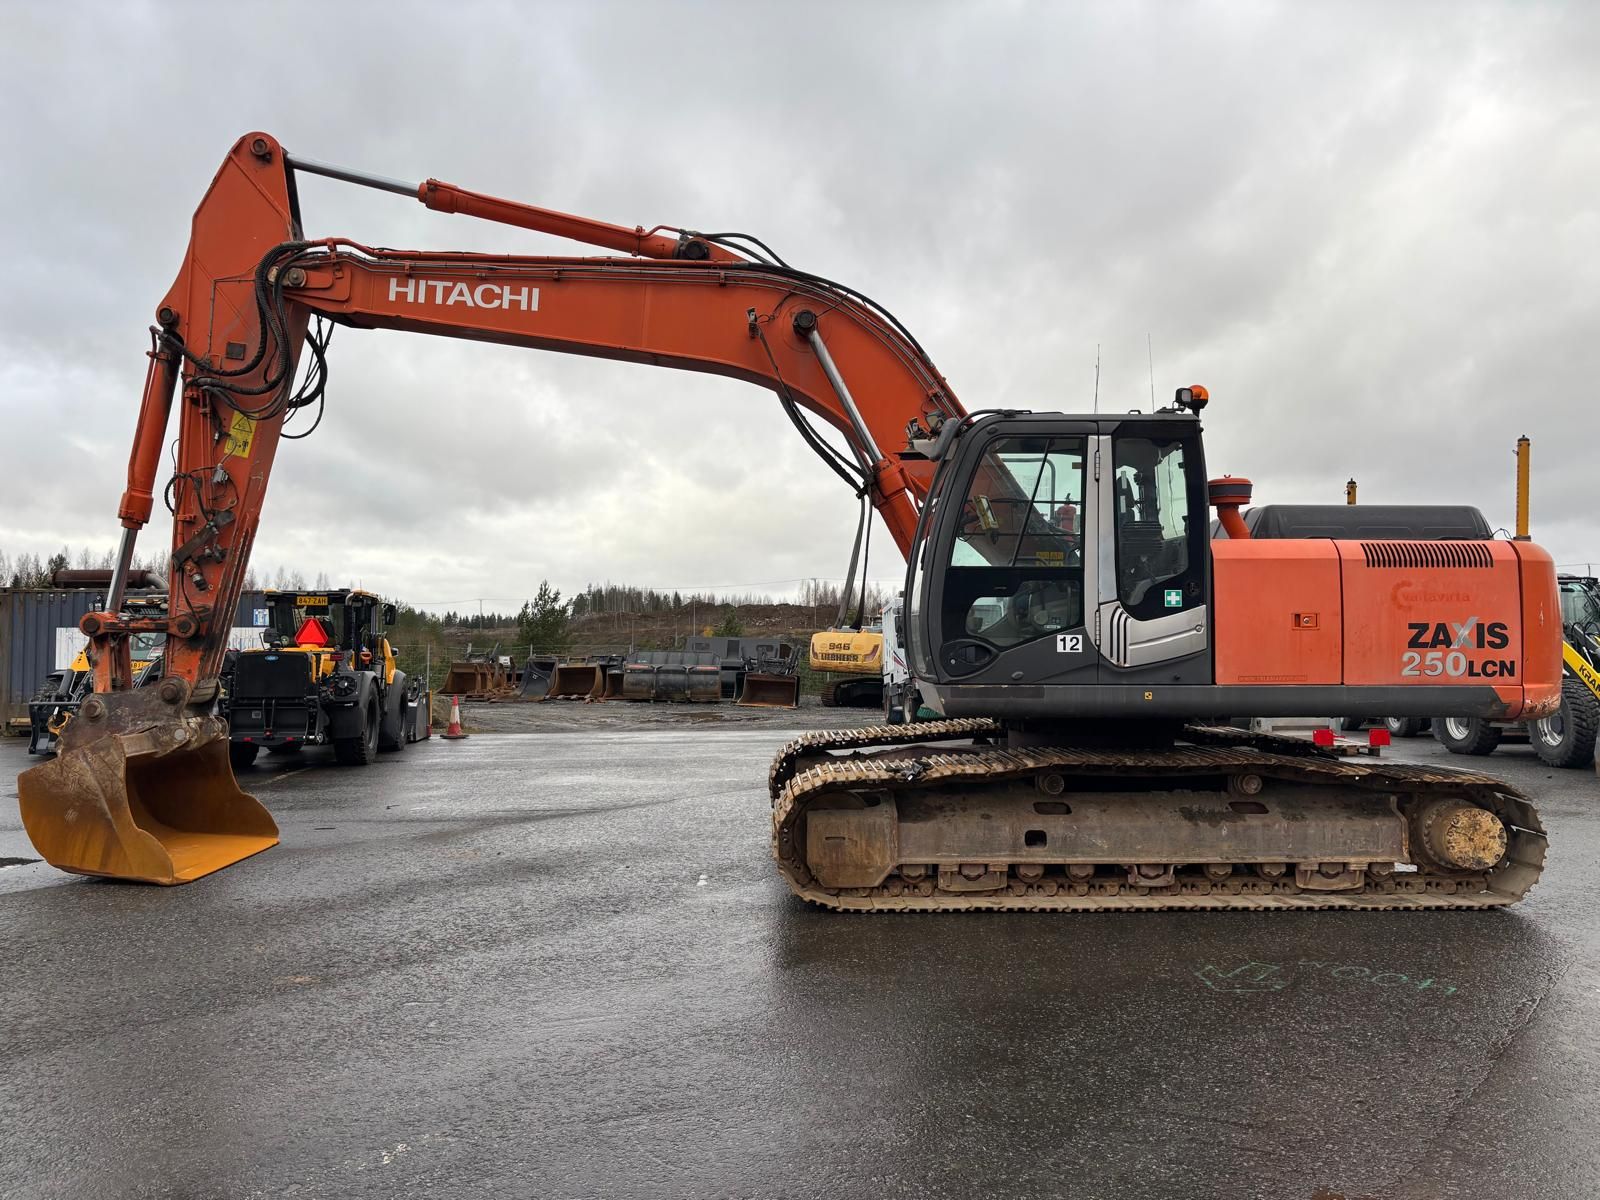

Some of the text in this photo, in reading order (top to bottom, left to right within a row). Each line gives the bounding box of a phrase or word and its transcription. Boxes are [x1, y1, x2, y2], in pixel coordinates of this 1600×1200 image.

[388, 277, 540, 312] HITACHI
[1060, 636, 1080, 651] 12
[1407, 616, 1509, 649] ZAXIS
